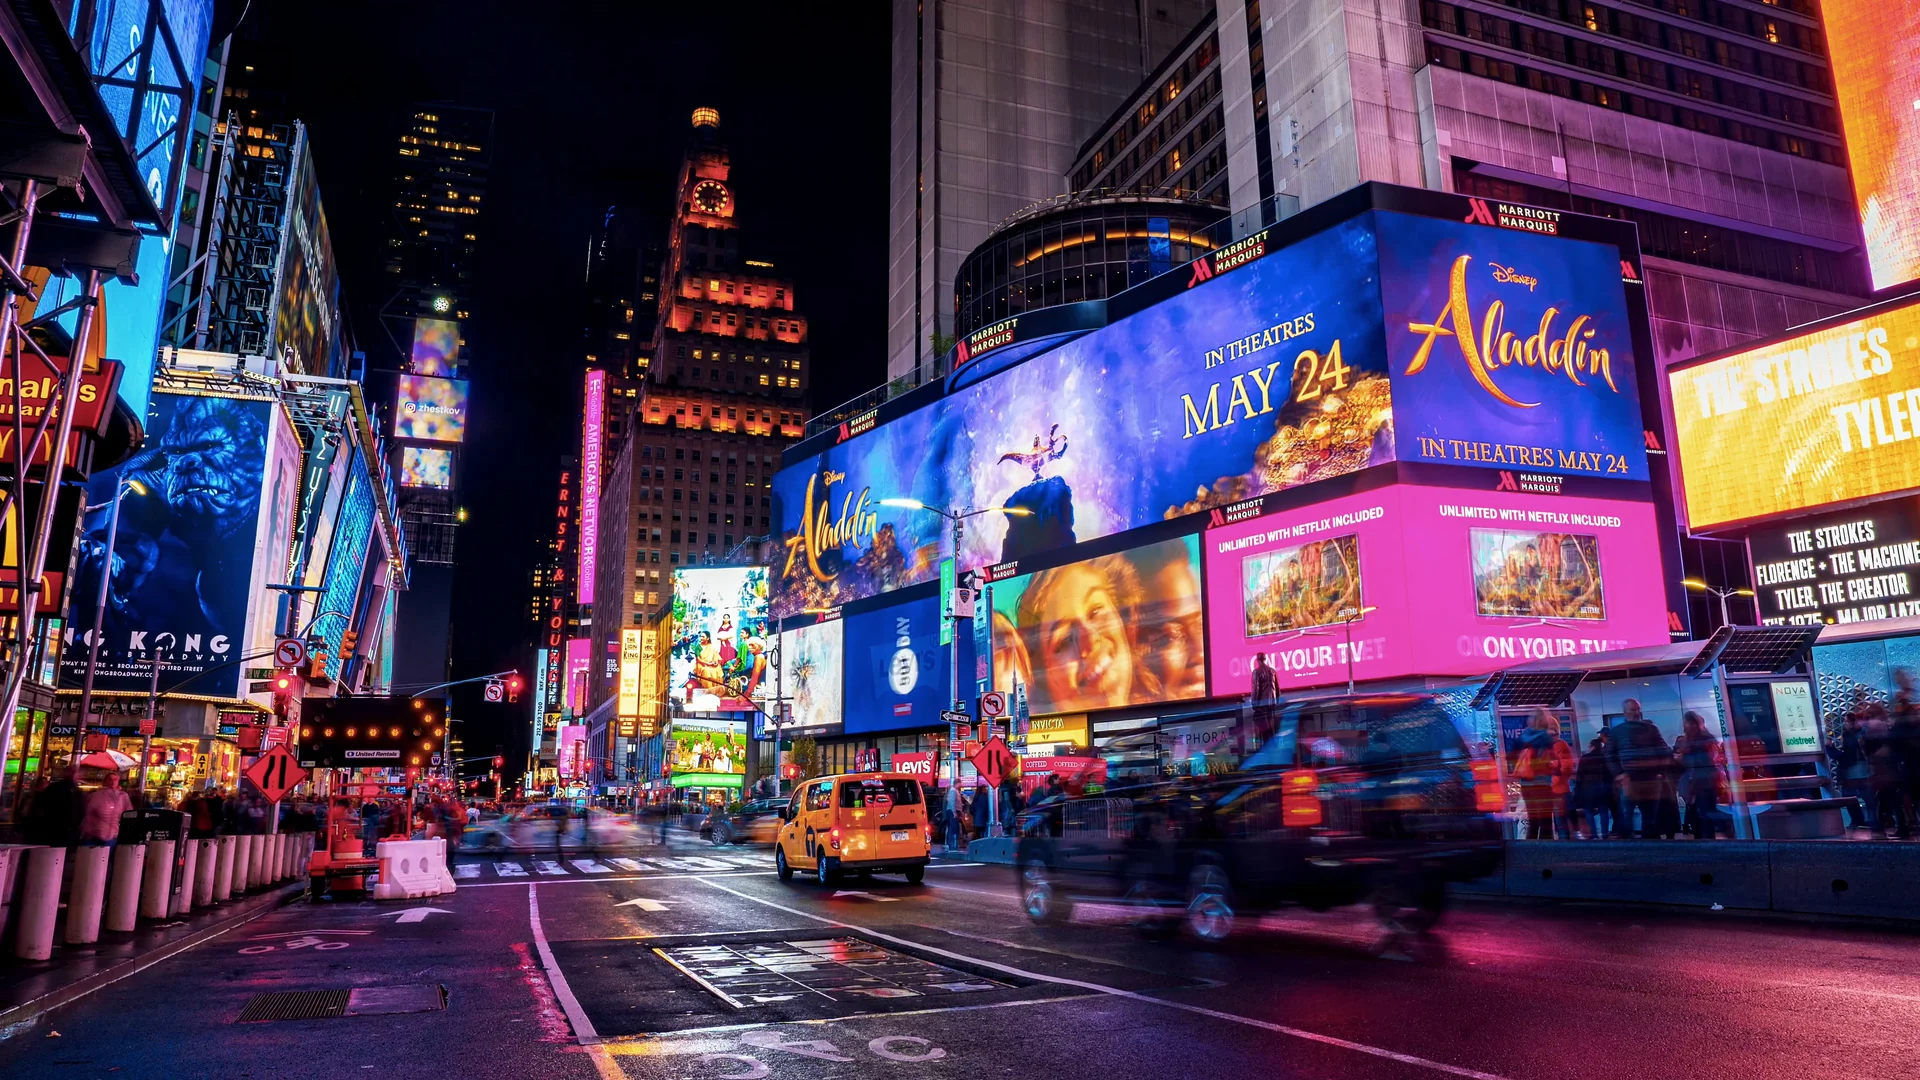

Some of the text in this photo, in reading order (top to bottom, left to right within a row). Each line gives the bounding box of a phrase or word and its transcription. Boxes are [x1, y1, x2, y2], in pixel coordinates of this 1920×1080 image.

[1498, 203, 1560, 223] MARRIOTT
[1499, 215, 1557, 234] MARQUIS
[1215, 230, 1268, 260] MARRIOTT
[1216, 243, 1264, 272] MARQUIS
[1488, 262, 1537, 292] Disney
[971, 318, 1018, 343] MARRIOTT
[1204, 312, 1315, 370] IN THEATRES
[1404, 255, 1620, 408] Aladdin
[971, 331, 1012, 354] MARQUIS
[1694, 327, 1893, 418] THE STROKES
[1180, 338, 1351, 440] MAY 24
[418, 404, 460, 415] zhestkov
[850, 409, 878, 427] MARRIOTT
[850, 419, 875, 435] MARQUIS
[587, 423, 598, 495] AMERICA'S
[1420, 437, 1629, 474] IN THEATRES MAY 24
[823, 470, 845, 486] Disney
[1520, 474, 1563, 484] MARRIOTT
[1521, 483, 1559, 492] MARQUIS
[557, 472, 570, 552] ERNST
[1227, 498, 1263, 513] MARRIOTT
[1227, 508, 1260, 522] MARQUIS
[1440, 505, 1621, 527] UNLIMITED WITH NETFLIX INCLUDED
[584, 497, 596, 565] NETWORK
[782, 473, 880, 582] Aladdin
[1218, 506, 1384, 553] UNLIMITED WITH NETFLIX INCLUDED
[1788, 520, 1875, 553] THE STROKES
[993, 561, 1018, 572] MARRIOTT
[993, 569, 1015, 579] MARQUIS
[1756, 542, 1920, 586] FLORENCE + THE MACHINE
[554, 569, 565, 582] &
[1775, 572, 1910, 611] TYLER, THE CREATOR
[130, 631, 231, 653] KONG
[896, 617, 910, 647] DAY
[128, 651, 229, 662] BRADWAY
[1280, 645, 1332, 671] YOUR
[1337, 641, 1363, 663] TV
[1483, 637, 1514, 658] ON
[1519, 637, 1576, 658] YOUR
[253, 670, 260, 678] W
[1776, 687, 1806, 695] NOVA
[1714, 686, 1729, 738] solstreet
[1031, 718, 1065, 730] INVICTA
[1786, 736, 1816, 745] solstreet
[197, 756, 206, 775] ATM
